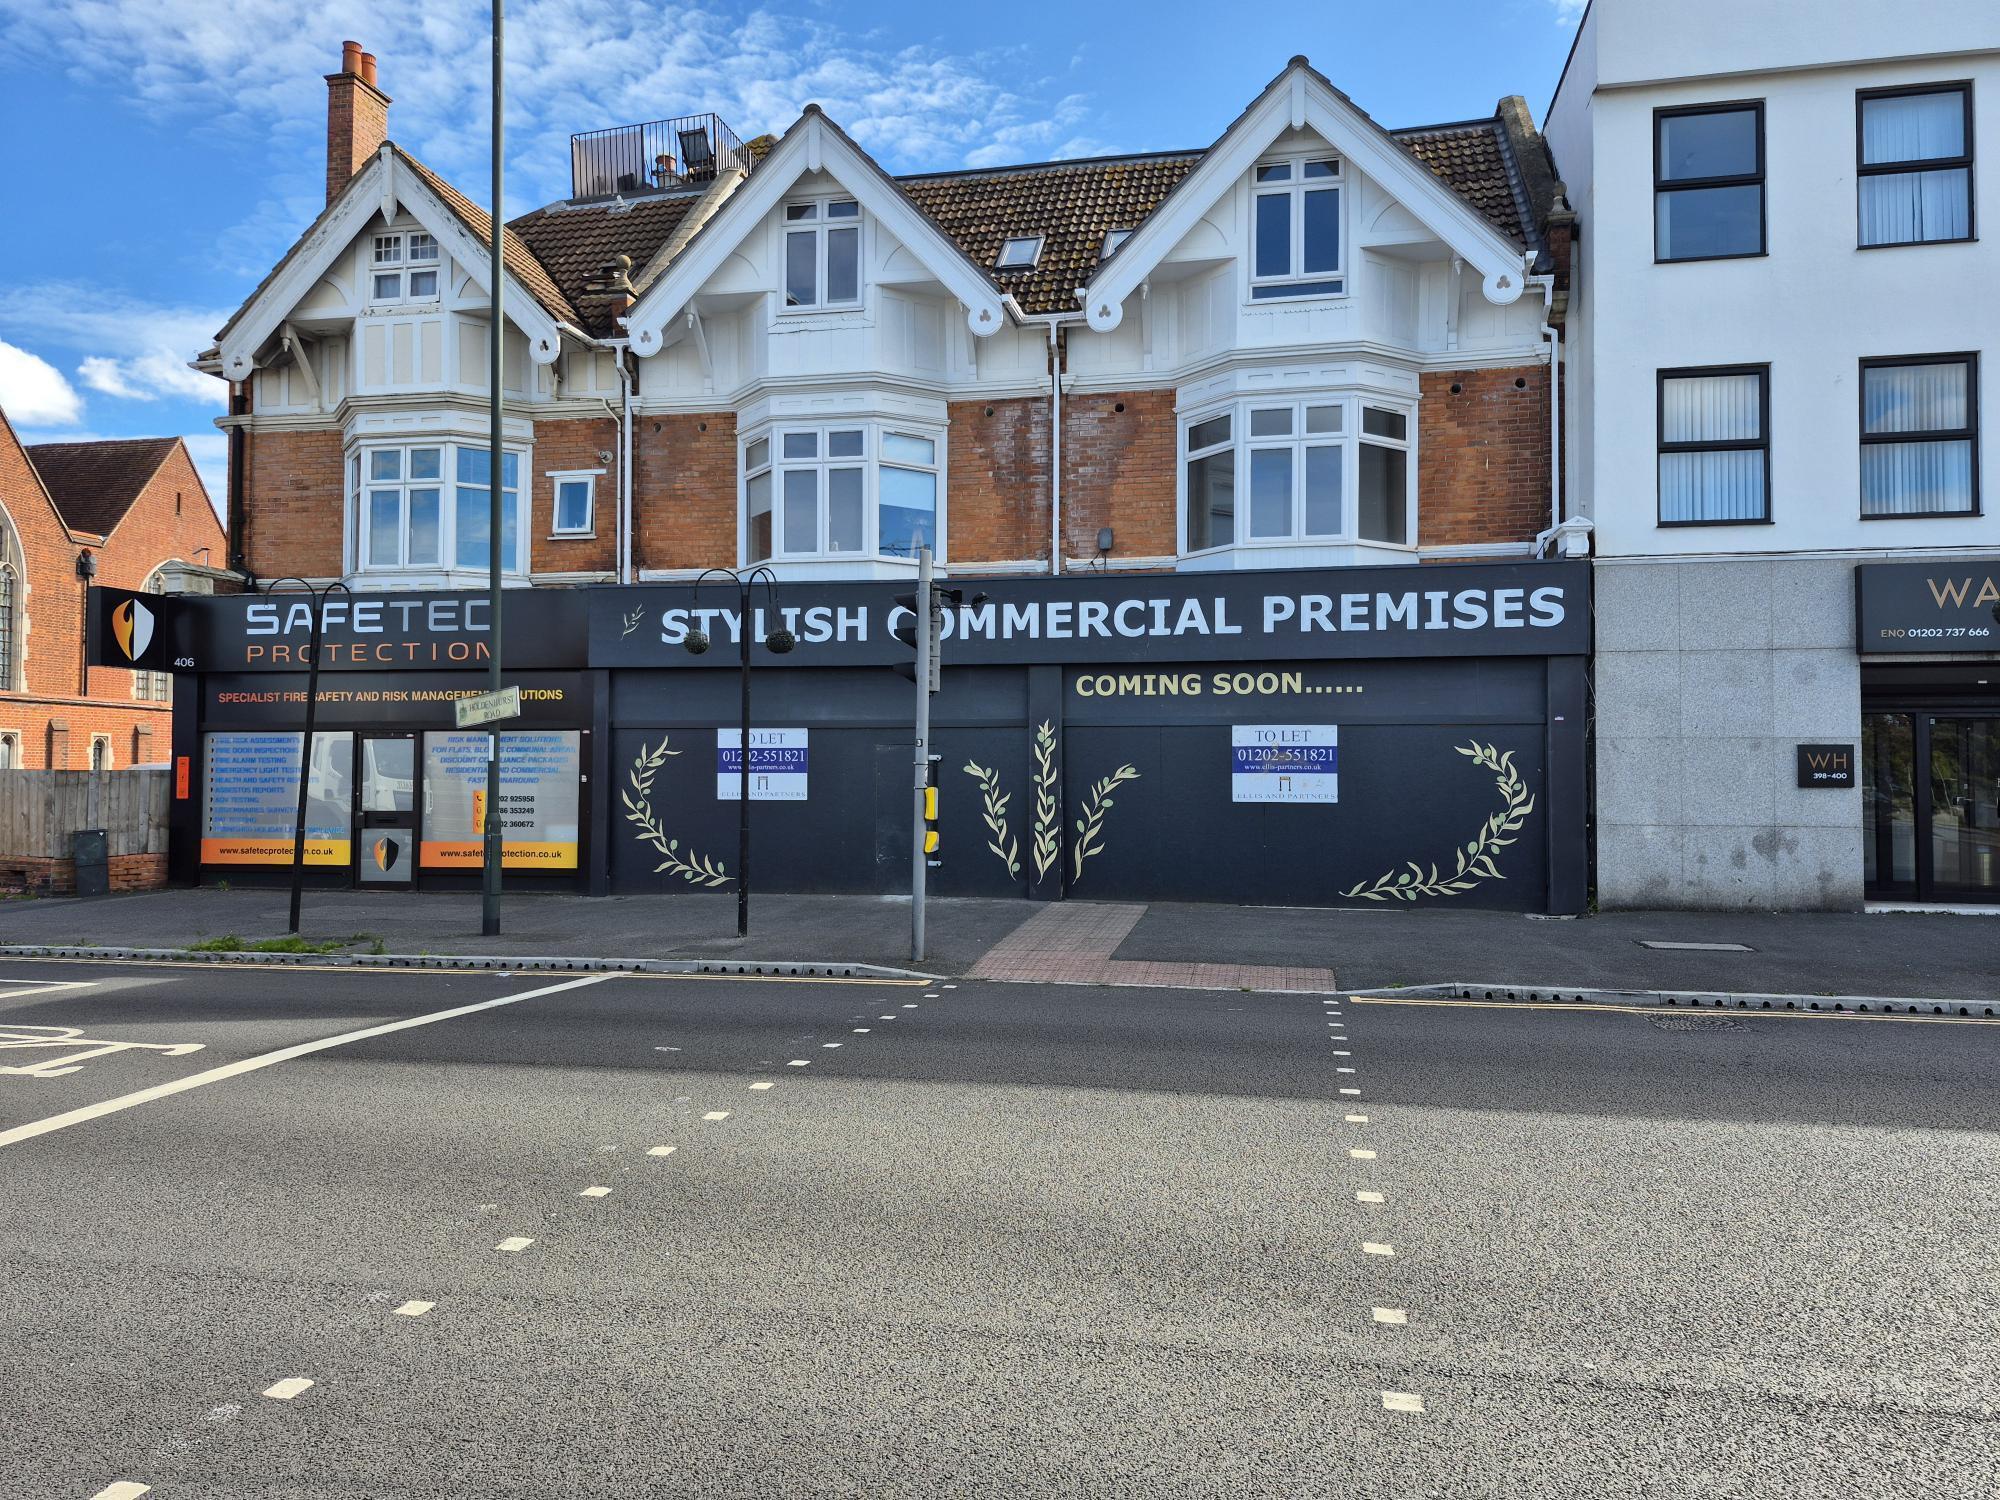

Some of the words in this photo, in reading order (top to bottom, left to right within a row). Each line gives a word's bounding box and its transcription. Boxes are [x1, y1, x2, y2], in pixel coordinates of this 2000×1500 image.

[246, 600, 491, 635] SAFETEC
[661, 606, 868, 644] STYLISH
[1263, 586, 1565, 633] PREMISES
[1881, 629, 1905, 638] ENQ
[1908, 628, 1943, 637] 01202
[1945, 627, 1966, 637] 737
[1968, 627, 1990, 637] 666
[246, 642, 491, 663] PROTECTION
[174, 657, 195, 668] 406
[1075, 673, 1202, 698] COMING
[218, 691, 280, 703] SPECIALIST
[283, 691, 308, 702] FIRE
[316, 690, 353, 702] AFETY
[355, 690, 380, 702] AND
[382, 690, 408, 702] RISK
[411, 689, 490, 702] MANAGEME
[520, 689, 563, 700] UTIONS
[760, 732, 786, 745] LET
[1254, 730, 1276, 743] TO
[1281, 730, 1311, 743] LET
[722, 750, 805, 763] 0122-551821
[1237, 748, 1334, 762] 01202-551821
[1807, 753, 1848, 769] WH
[1244, 763, 1322, 772] www.ellis-partners.co.uk
[1813, 771, 1848, 780] 398-400
[509, 807, 535, 815] 353249
[509, 820, 535, 828] 360672
